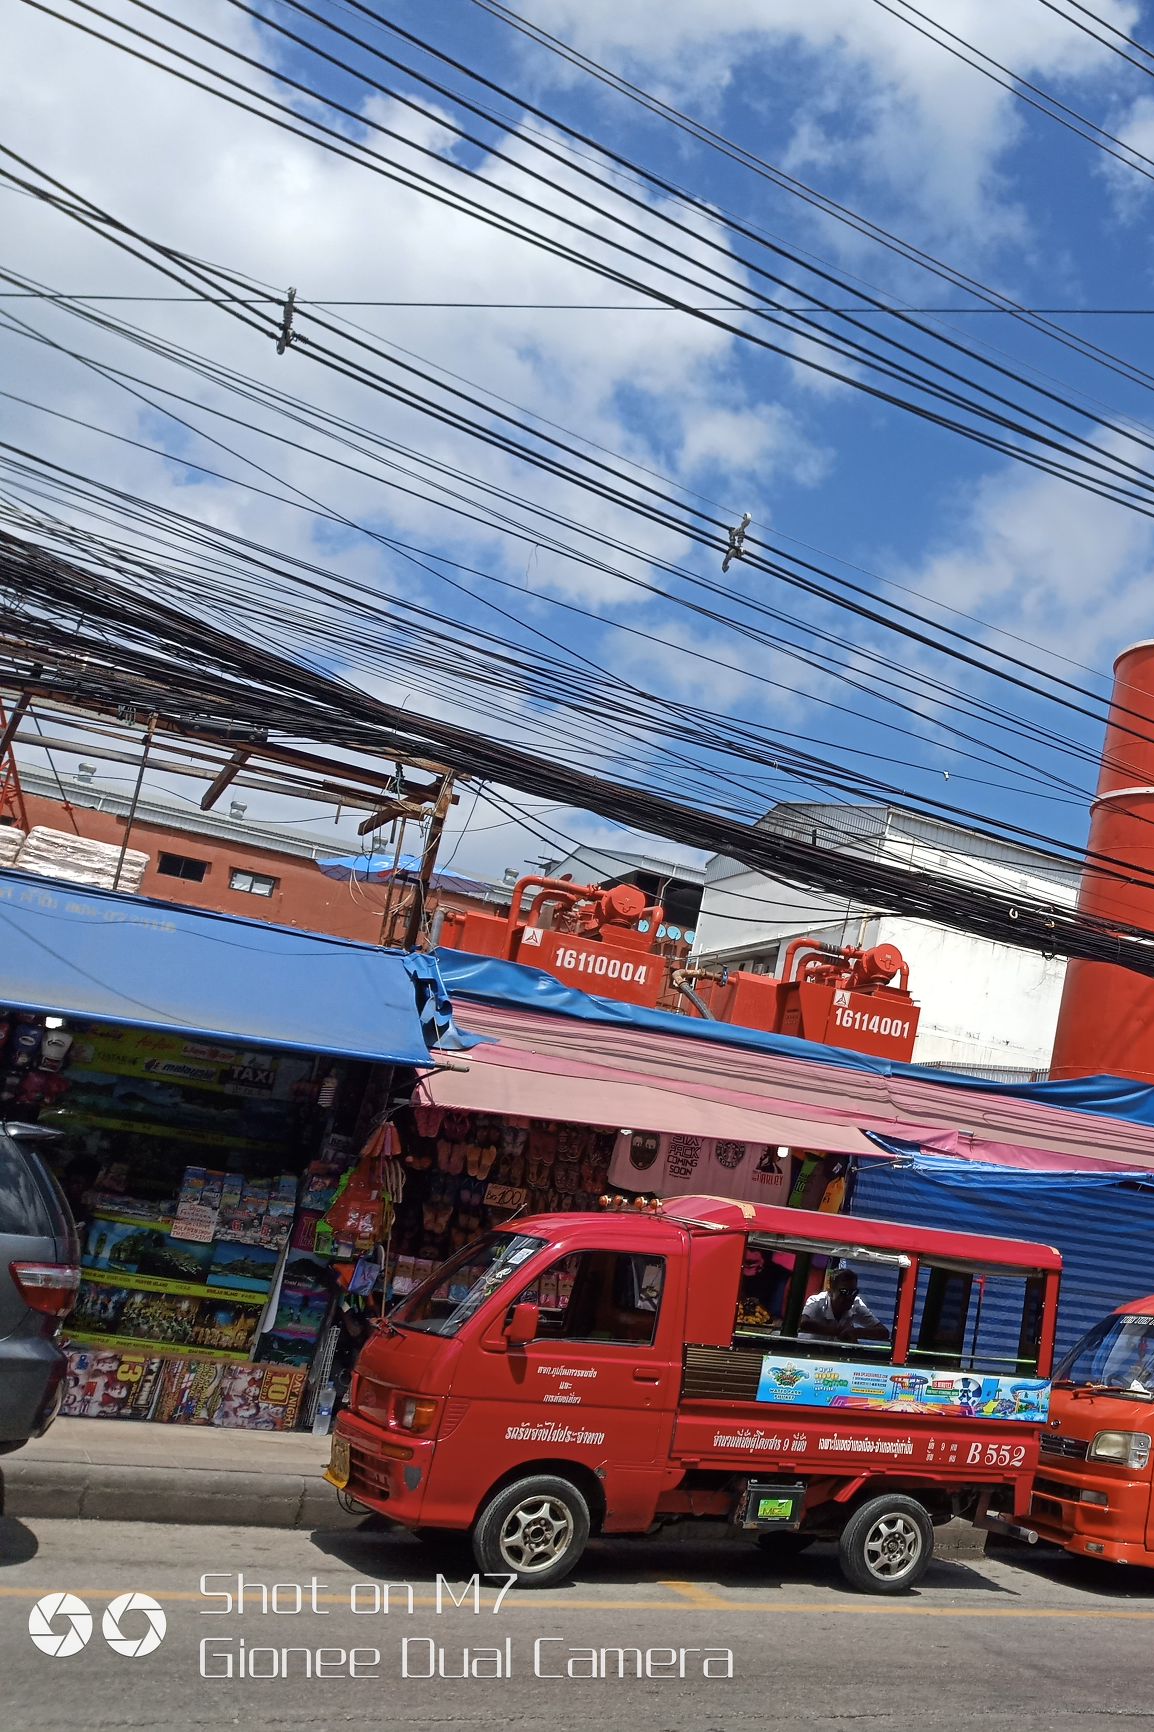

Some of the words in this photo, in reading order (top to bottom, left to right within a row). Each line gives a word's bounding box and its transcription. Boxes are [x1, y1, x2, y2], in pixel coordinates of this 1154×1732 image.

[555, 947, 648, 986] 16110004
[834, 1006, 910, 1040] 16114001
[231, 1065, 274, 1084] TAXI
[667, 1154, 698, 1168] COMING
[669, 1164, 693, 1177] SOON
[268, 1374, 290, 1400] 10
[291, 1374, 304, 1395] DAY
[284, 1396, 298, 1427] NIGHT
[504, 1421, 605, 1446] รถรับจ้างไม่ประจำทาง
[783, 1438, 790, 1452] 9
[966, 1442, 983, 1465] B
[984, 1444, 1027, 1467] 552
